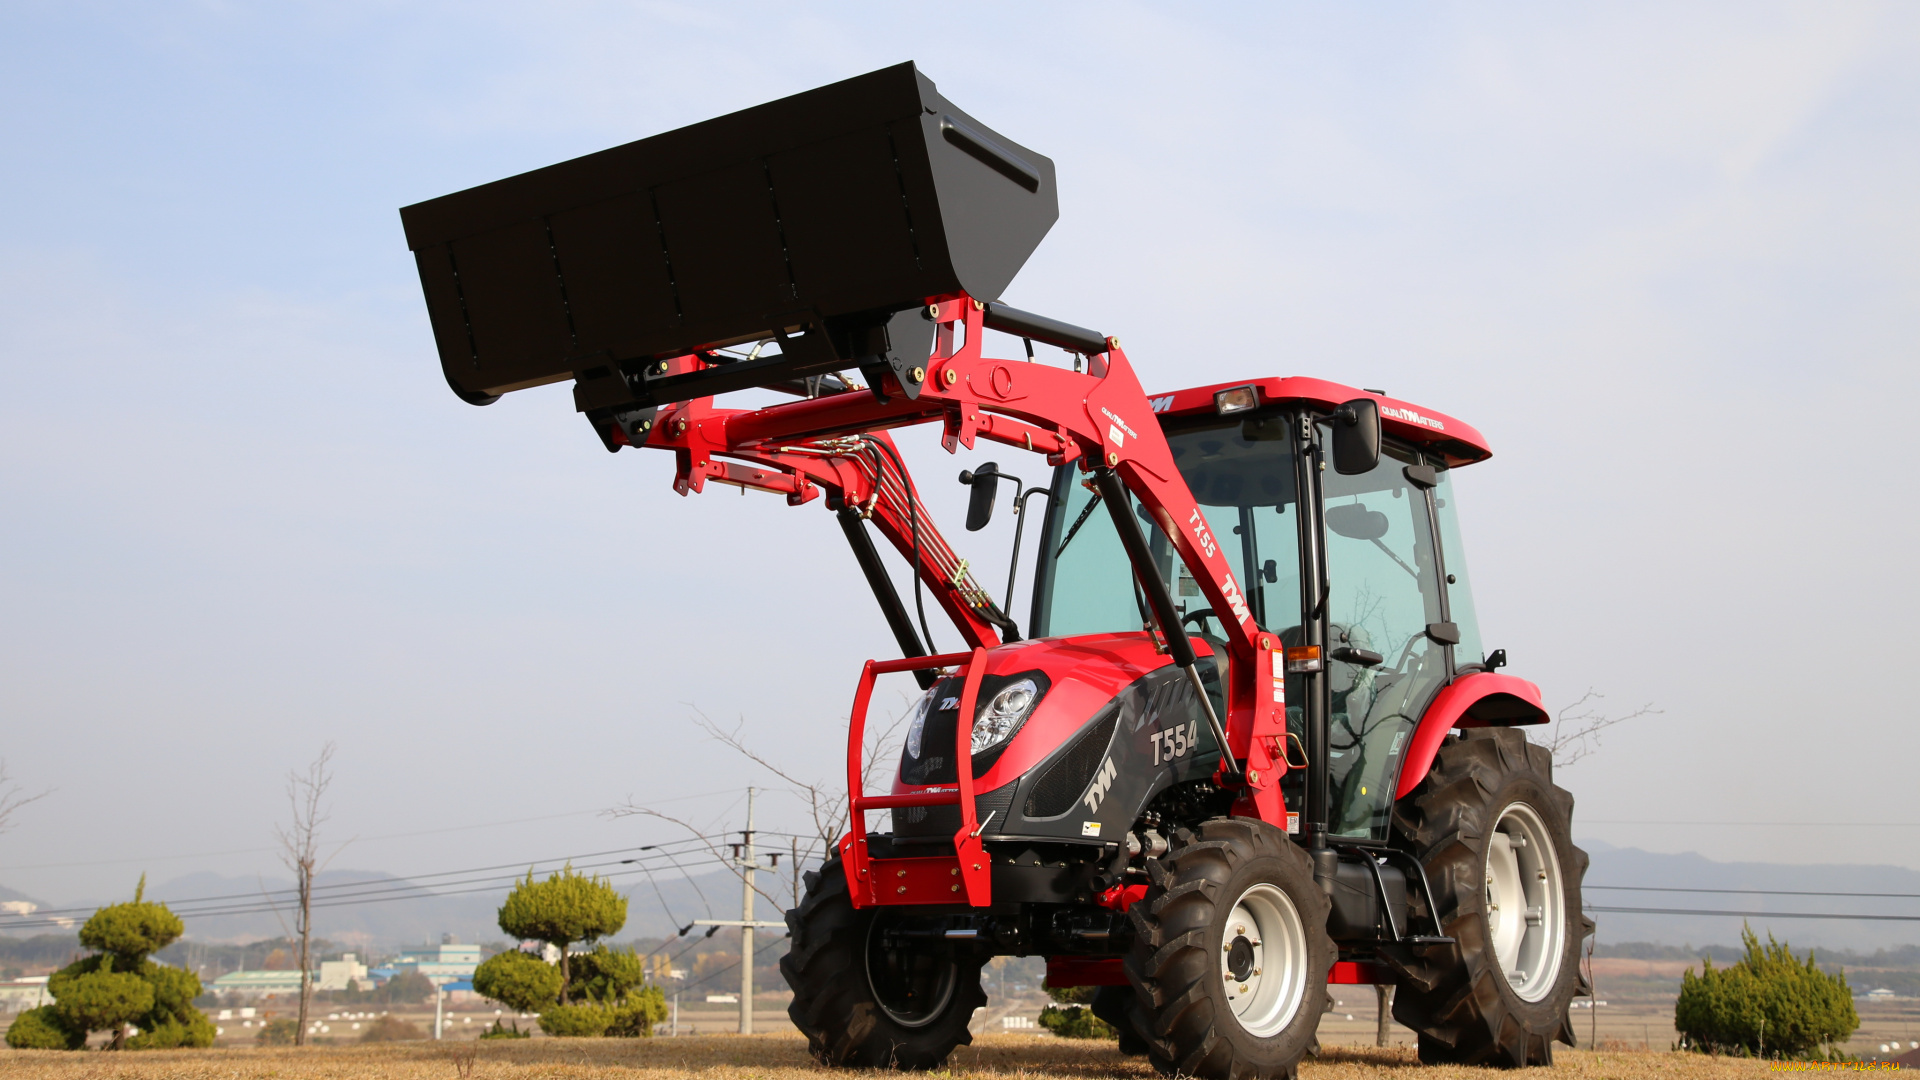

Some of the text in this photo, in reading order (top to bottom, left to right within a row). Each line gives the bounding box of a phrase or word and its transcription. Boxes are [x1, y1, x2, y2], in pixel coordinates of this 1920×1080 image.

[1189, 508, 1216, 558] TX55
[1221, 573, 1250, 626] TYM
[1150, 719, 1200, 767] T554
[1083, 755, 1118, 815] TYM
